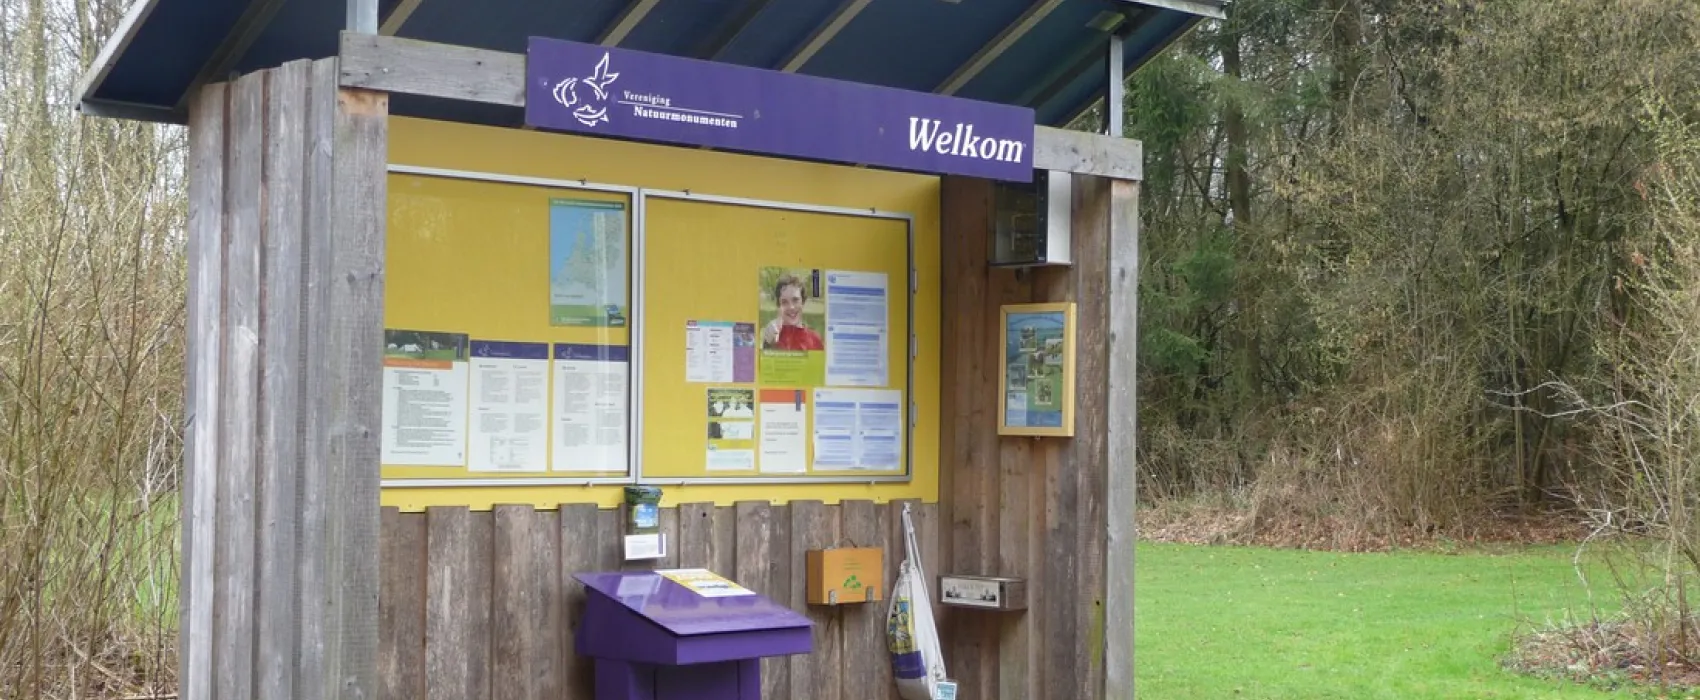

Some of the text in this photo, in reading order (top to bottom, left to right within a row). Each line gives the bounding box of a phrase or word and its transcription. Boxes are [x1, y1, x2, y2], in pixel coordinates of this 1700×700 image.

[623, 90, 671, 107] Vereniging
[633, 106, 738, 128] Natuurmonumenten
[909, 116, 1024, 164] Welkom
